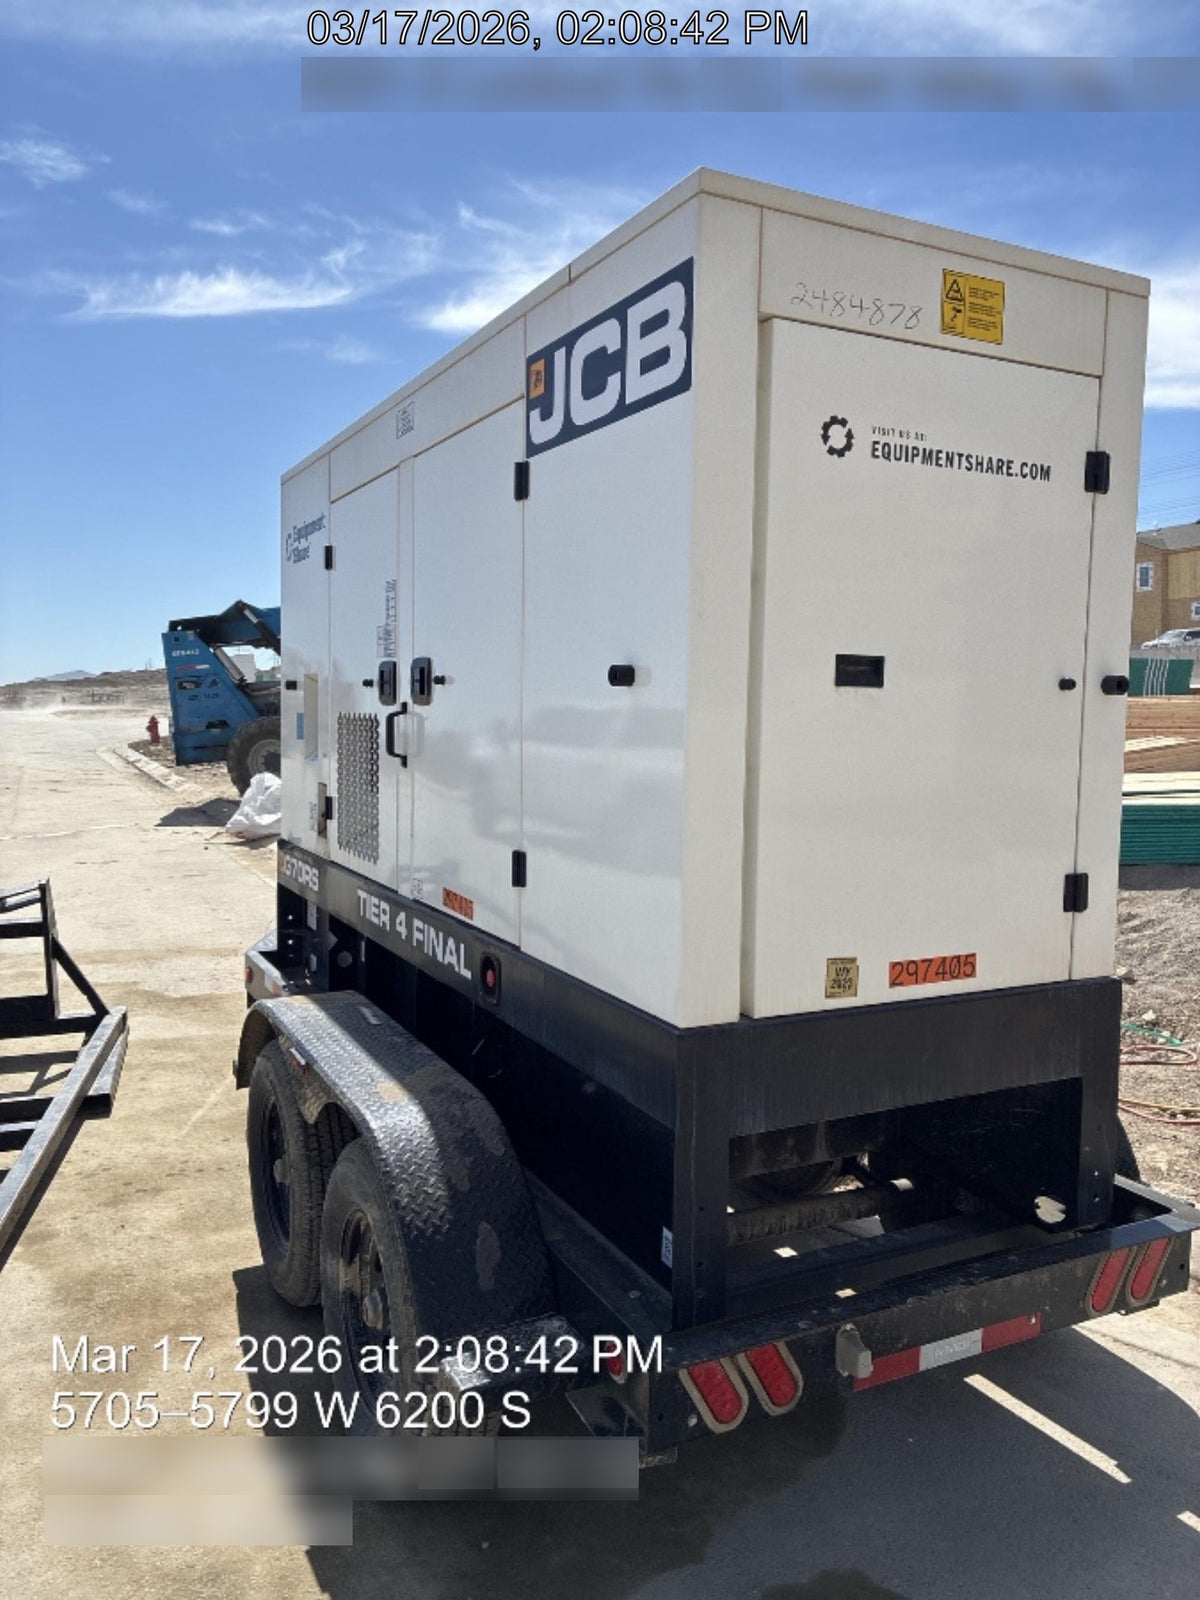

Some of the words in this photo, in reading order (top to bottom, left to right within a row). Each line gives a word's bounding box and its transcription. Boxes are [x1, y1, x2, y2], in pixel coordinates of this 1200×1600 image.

[791, 282, 923, 330] 2484878
[529, 280, 687, 445] JCB
[870, 440, 1051, 482] EQUIPMENTSHARE.COM
[357, 888, 390, 931] TIER
[396, 911, 407, 940] 4
[413, 917, 472, 980] FINAL
[891, 954, 977, 988] 297405
